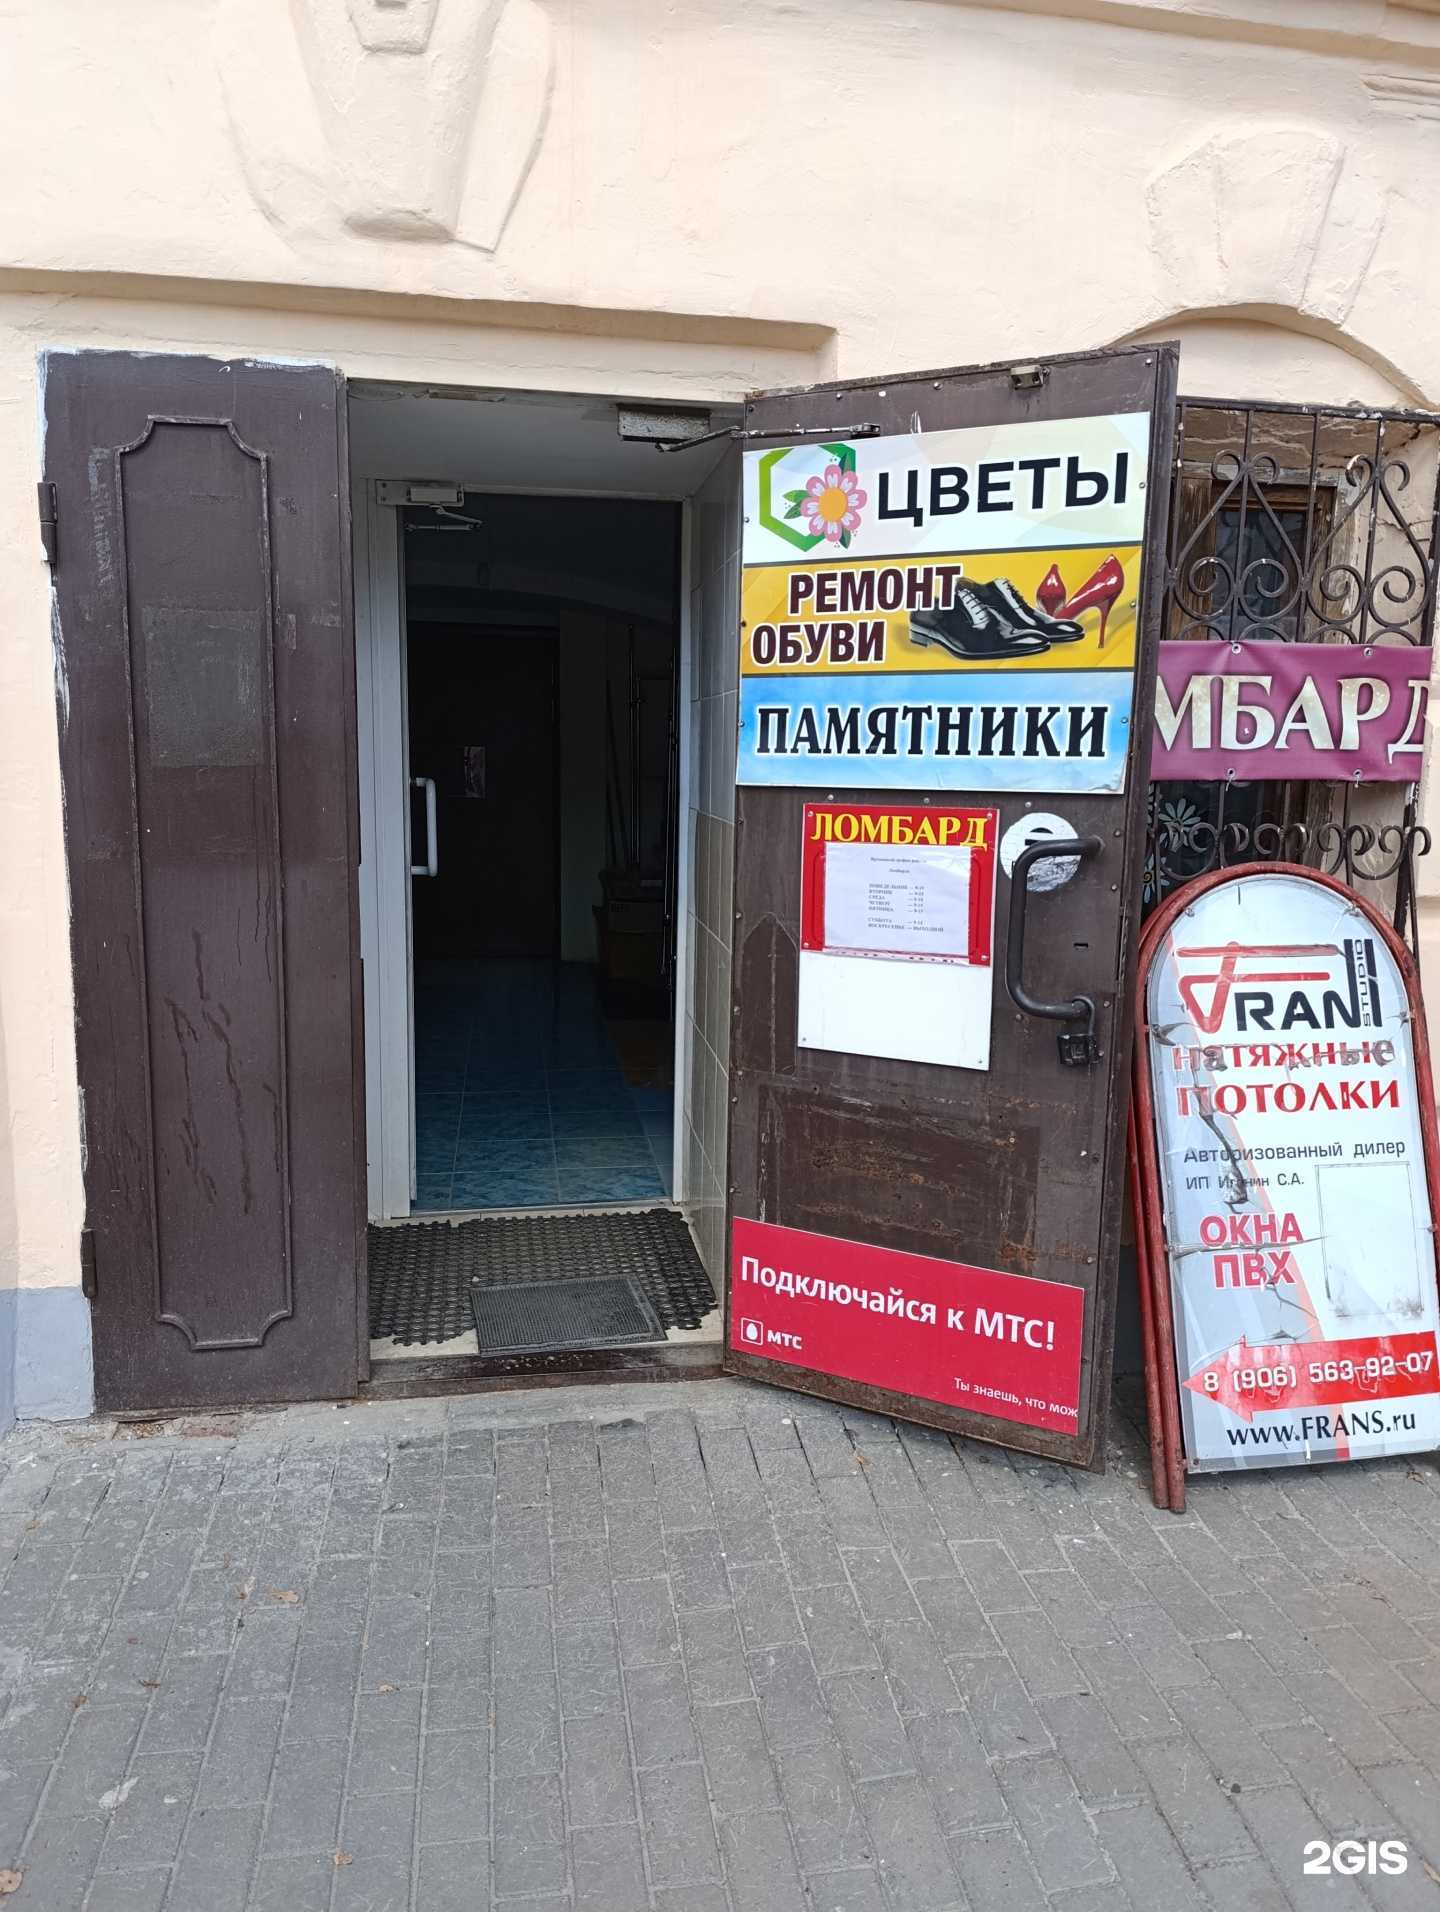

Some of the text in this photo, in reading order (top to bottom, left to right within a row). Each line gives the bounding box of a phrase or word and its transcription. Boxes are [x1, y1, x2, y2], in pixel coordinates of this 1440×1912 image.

[877, 452, 1129, 528] ЦВЕТЫ
[789, 565, 961, 614] РЕМОНТ
[752, 621, 885, 665] ОБУВИ
[757, 705, 1108, 757] ПАМЯТНИКИ
[811, 813, 988, 851] ЛОМБАРД
[1184, 1141, 1406, 1163] Авторизованный дилер
[1186, 1176, 1209, 1190] ИП
[1277, 1172, 1304, 1186] С.А.
[1200, 1212, 1304, 1247] ОКНА
[1213, 1251, 1296, 1288] ПВХ
[741, 1255, 1055, 1351] Подключайся к МТС!
[1203, 1351, 1433, 1392] 8 (906) 563-92-07
[954, 1377, 970, 1391] Ты
[973, 1384, 1022, 1406] знаешь,
[1025, 1396, 1046, 1410] что
[1227, 1410, 1416, 1446] www.FRANS.ru
